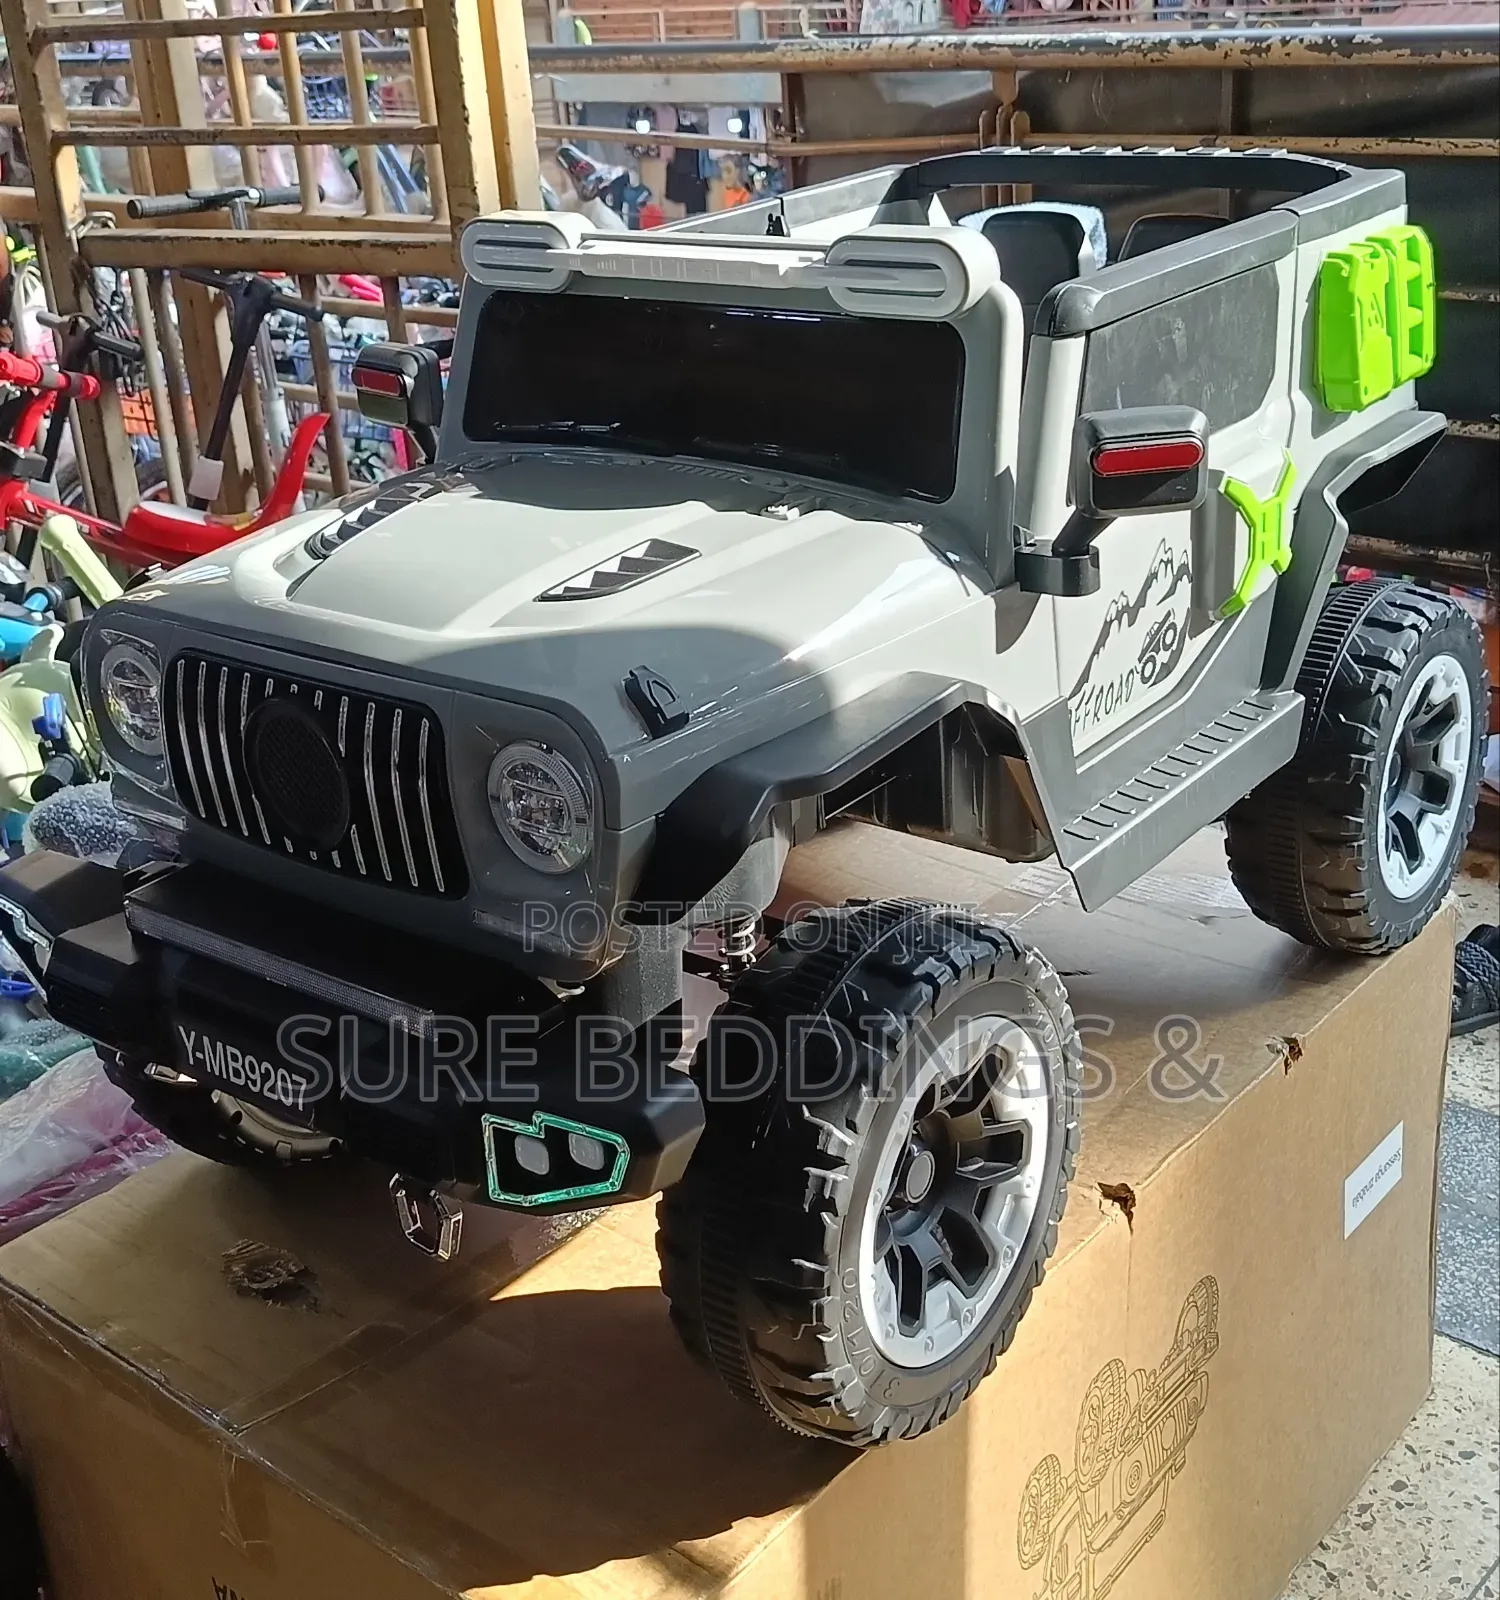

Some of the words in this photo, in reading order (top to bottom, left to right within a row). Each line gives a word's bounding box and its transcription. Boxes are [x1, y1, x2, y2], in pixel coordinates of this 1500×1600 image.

[1068, 667, 1135, 737] FFROAD
[178, 1025, 307, 1111] Y-MB9207
[841, 1267, 900, 1400] 310/120
